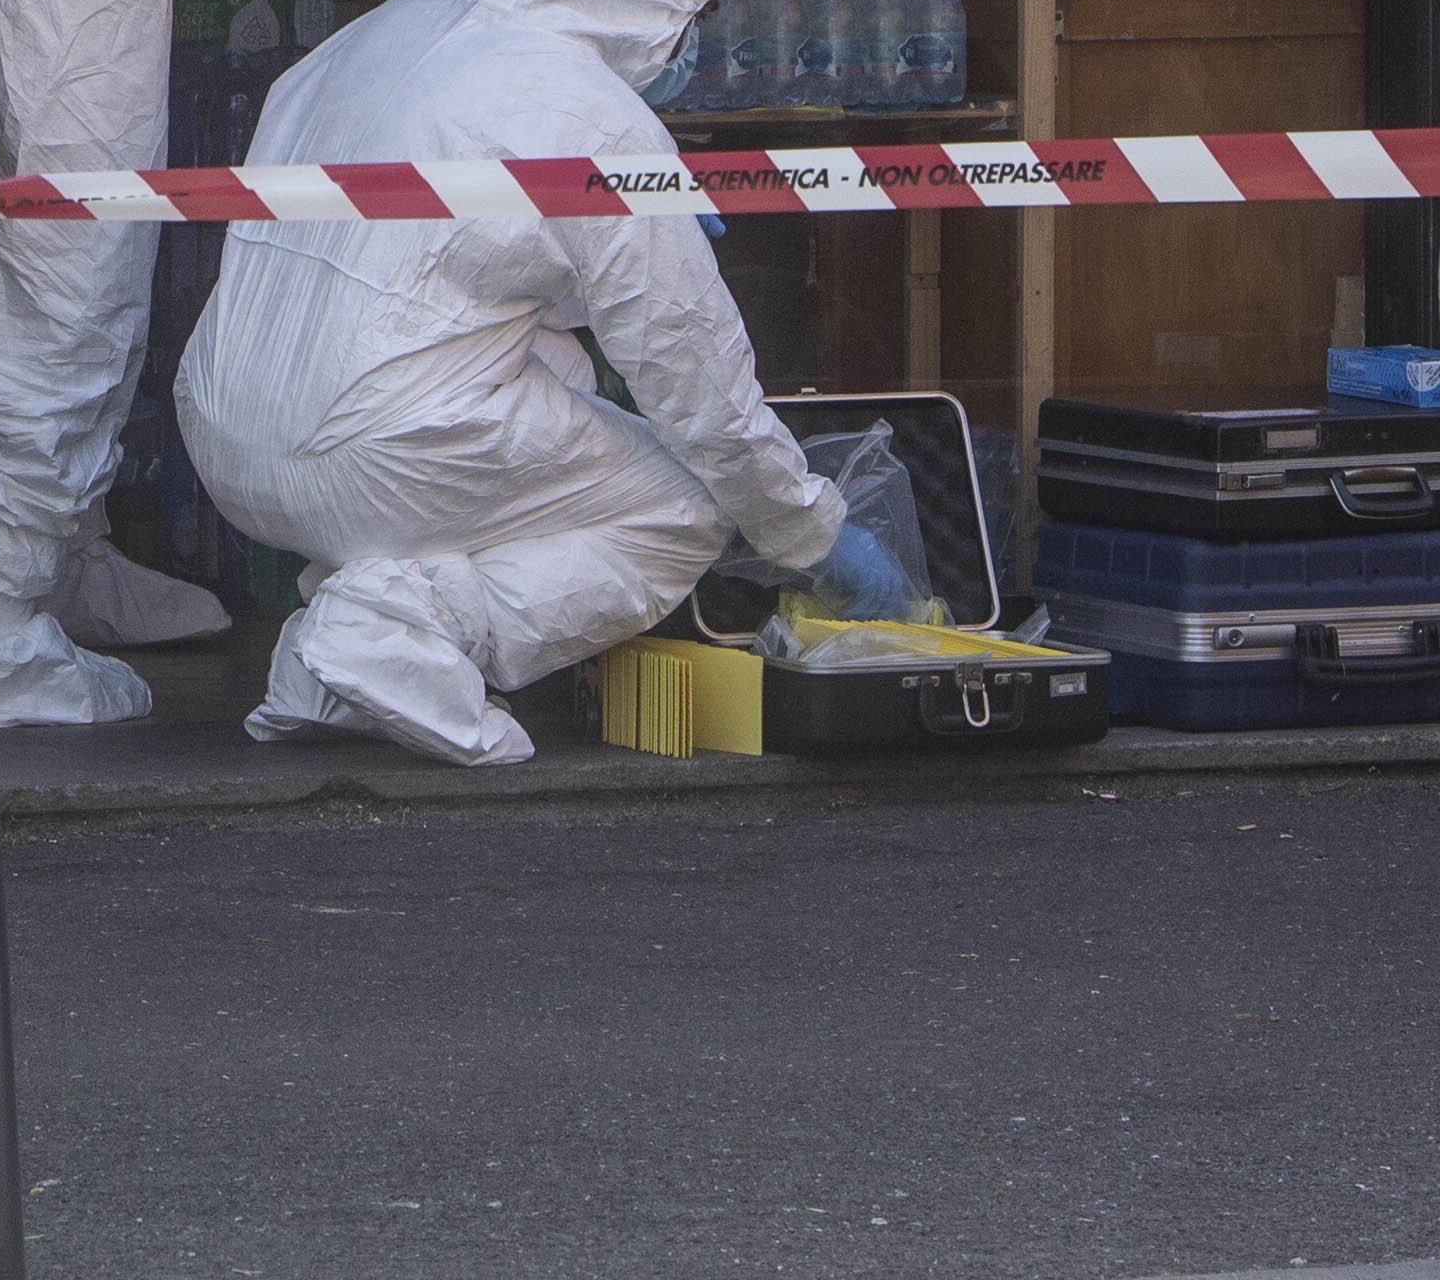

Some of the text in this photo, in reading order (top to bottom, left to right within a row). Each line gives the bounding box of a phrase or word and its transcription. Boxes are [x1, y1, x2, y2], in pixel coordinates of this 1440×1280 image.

[585, 171, 681, 195] POLIZIA
[689, 167, 831, 193] SCIENTIFICA
[858, 164, 924, 189] NON
[927, 158, 1107, 187] OLTREPASSARE
